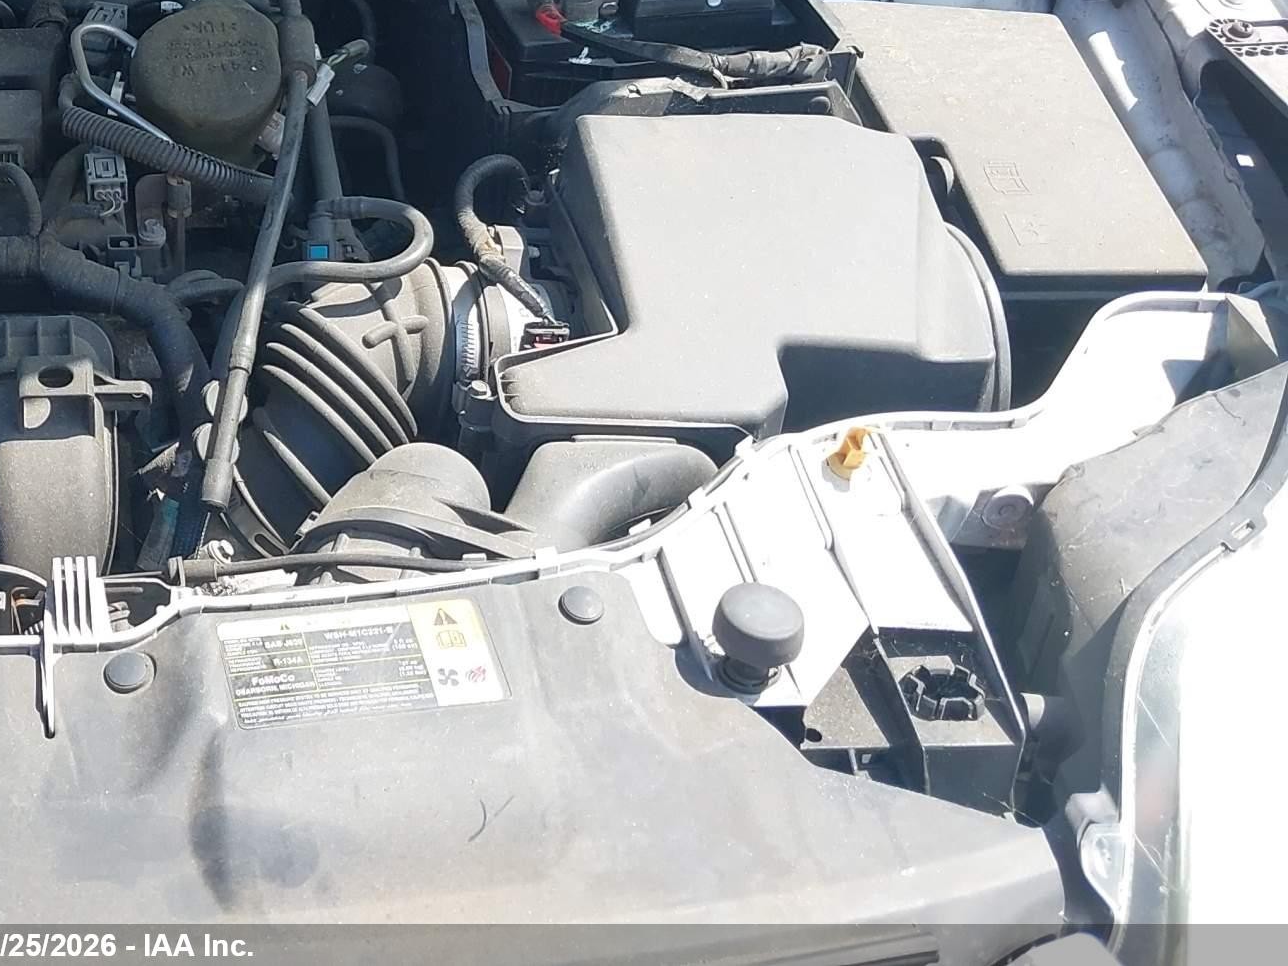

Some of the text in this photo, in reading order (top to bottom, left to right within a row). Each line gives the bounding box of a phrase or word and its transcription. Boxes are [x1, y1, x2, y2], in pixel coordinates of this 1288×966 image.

[273, 657, 304, 667] R-134A
[251, 673, 296, 686] FoMoCo
[279, 681, 316, 692] MICHIGAN
